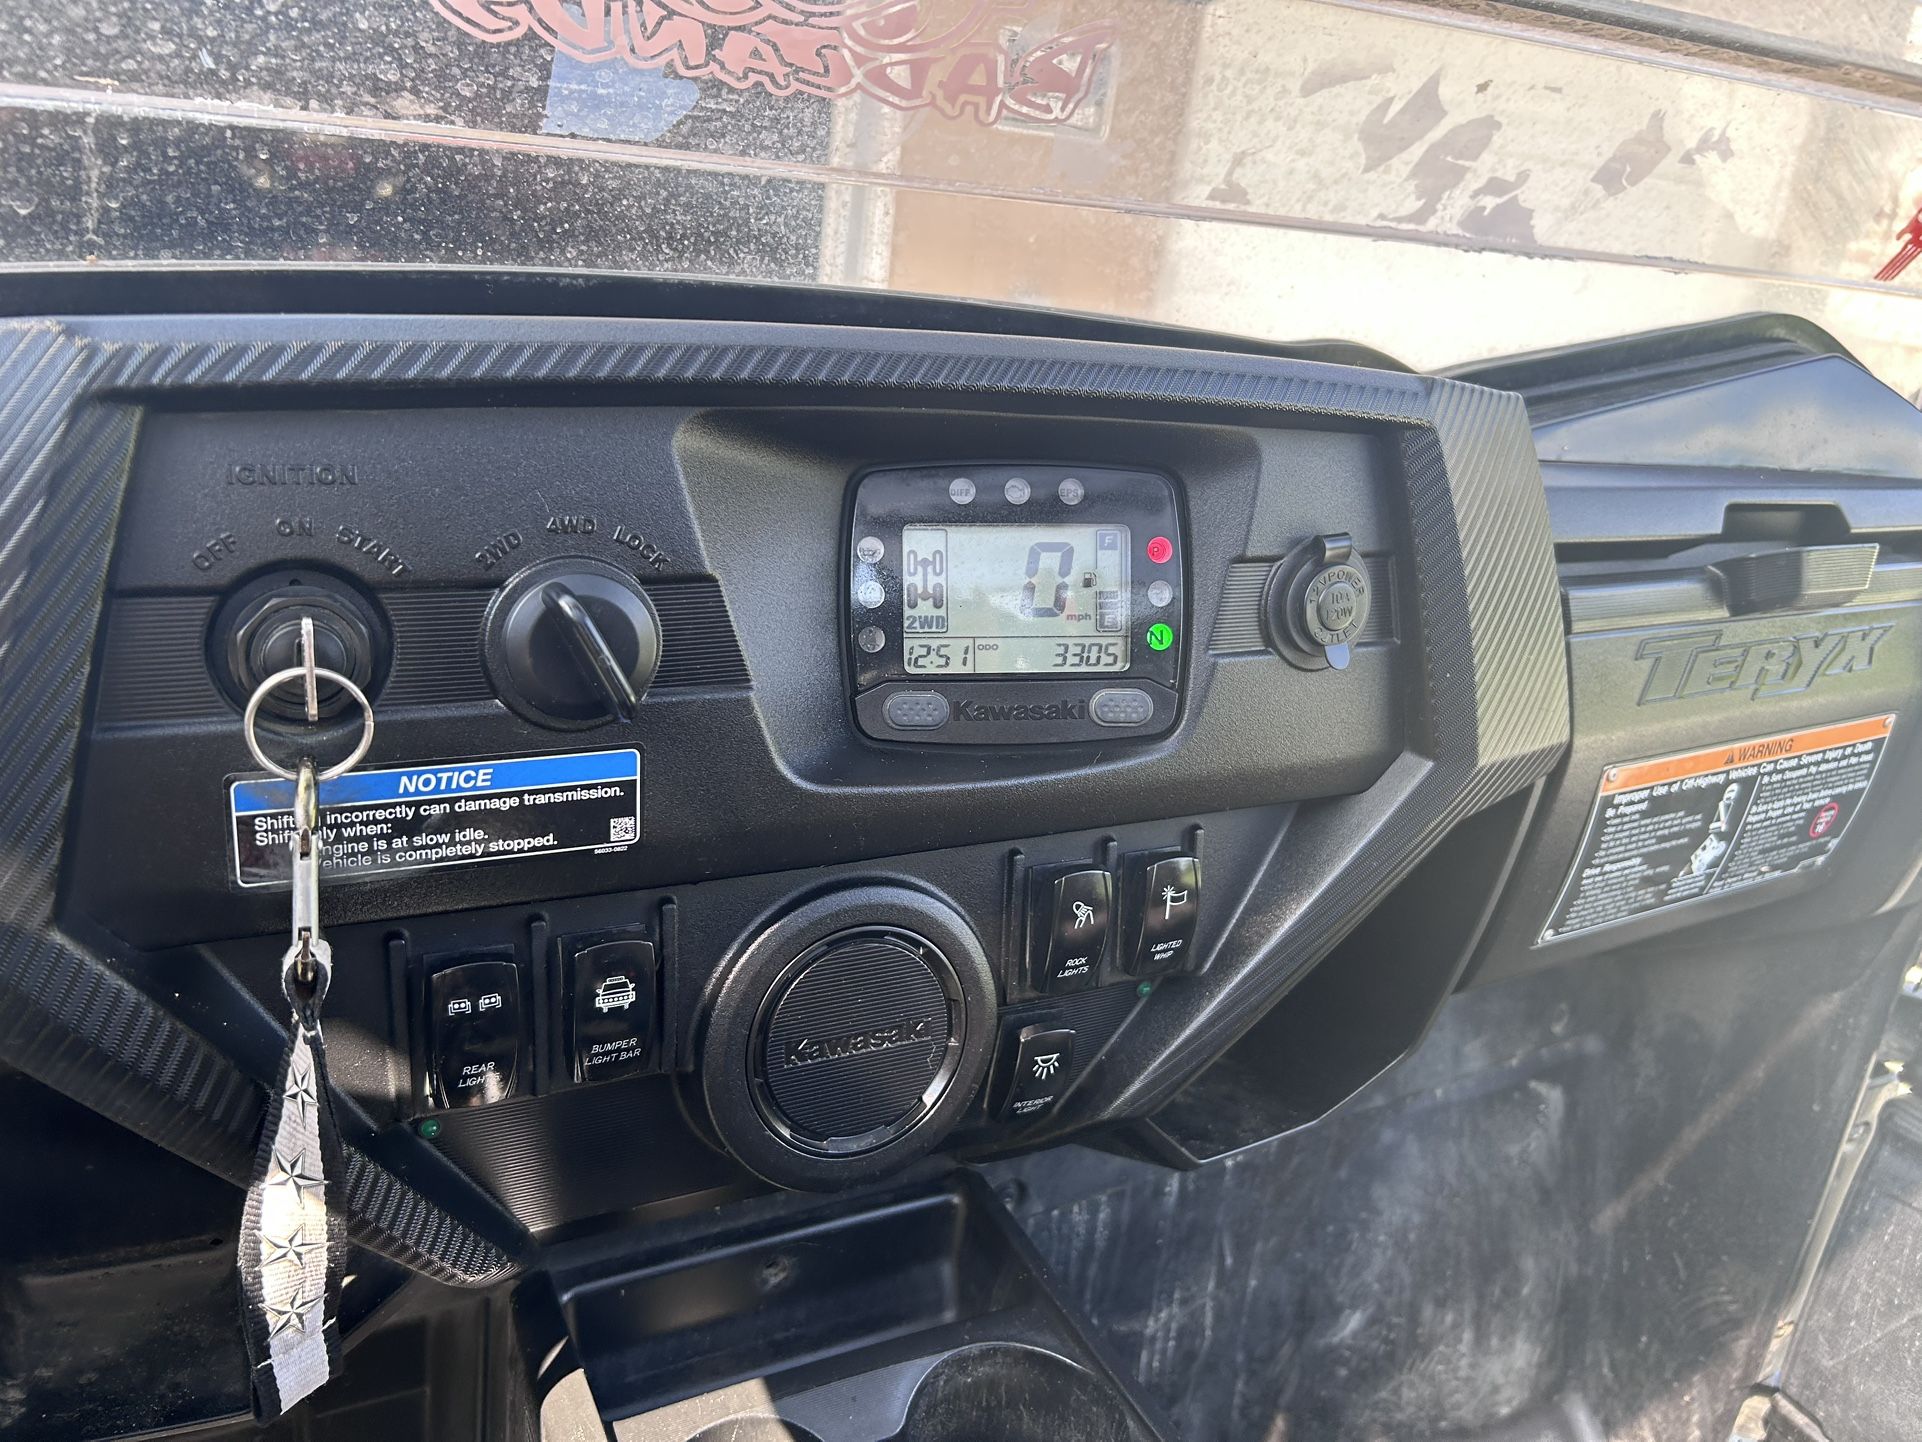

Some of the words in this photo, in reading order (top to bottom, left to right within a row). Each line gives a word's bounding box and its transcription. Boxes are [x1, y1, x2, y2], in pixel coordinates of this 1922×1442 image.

[226, 463, 358, 486] IGNITION
[950, 488, 971, 497] DIFF
[1059, 488, 1079, 498] EPS
[275, 517, 314, 537] ON
[546, 515, 597, 534] 4WD
[191, 531, 237, 571] OFF
[335, 525, 413, 575] START
[475, 529, 523, 571] 2WD
[613, 525, 670, 572] LOCK
[905, 615, 946, 631] 2WD
[1066, 612, 1092, 622] mph
[977, 643, 999, 651] ODO
[1149, 629, 1164, 646] N
[907, 643, 970, 669] 12:51
[1052, 642, 1119, 668] 3305
[952, 699, 1087, 722] Kawasaki
[1738, 738, 1794, 762] WARNING
[398, 768, 494, 794] NOTICE
[1652, 785, 1669, 797] Use
[1670, 781, 1680, 793] of
[1728, 766, 1759, 780] Vehicles
[1760, 762, 1774, 774] Can
[1777, 758, 1798, 770] Cause
[1800, 753, 1823, 765] Severe
[1825, 748, 1844, 760] Injury
[326, 804, 416, 823] incorrectly
[419, 802, 450, 816] can
[454, 797, 520, 813] damage
[523, 786, 625, 806] transmission.
[341, 822, 392, 838] when:
[319, 854, 372, 870] ehicle
[377, 850, 391, 864] is
[395, 841, 485, 862] completely
[489, 833, 558, 852] stopped.
[320, 841, 369, 858] ngine
[373, 838, 387, 851] is
[392, 835, 408, 849] at
[412, 832, 450, 847] slow
[455, 827, 489, 842] idle.
[1151, 939, 1183, 951] LIGHTED
[1065, 957, 1087, 967] ROCK
[1154, 950, 1175, 961] WHIP
[1057, 965, 1090, 978] LIGHTS
[591, 1037, 638, 1054] BUMPER
[783, 1017, 933, 1068] Kawasaki
[584, 1050, 616, 1066] LIGHT
[618, 1048, 642, 1062] BAR
[462, 1061, 496, 1076] REAR
